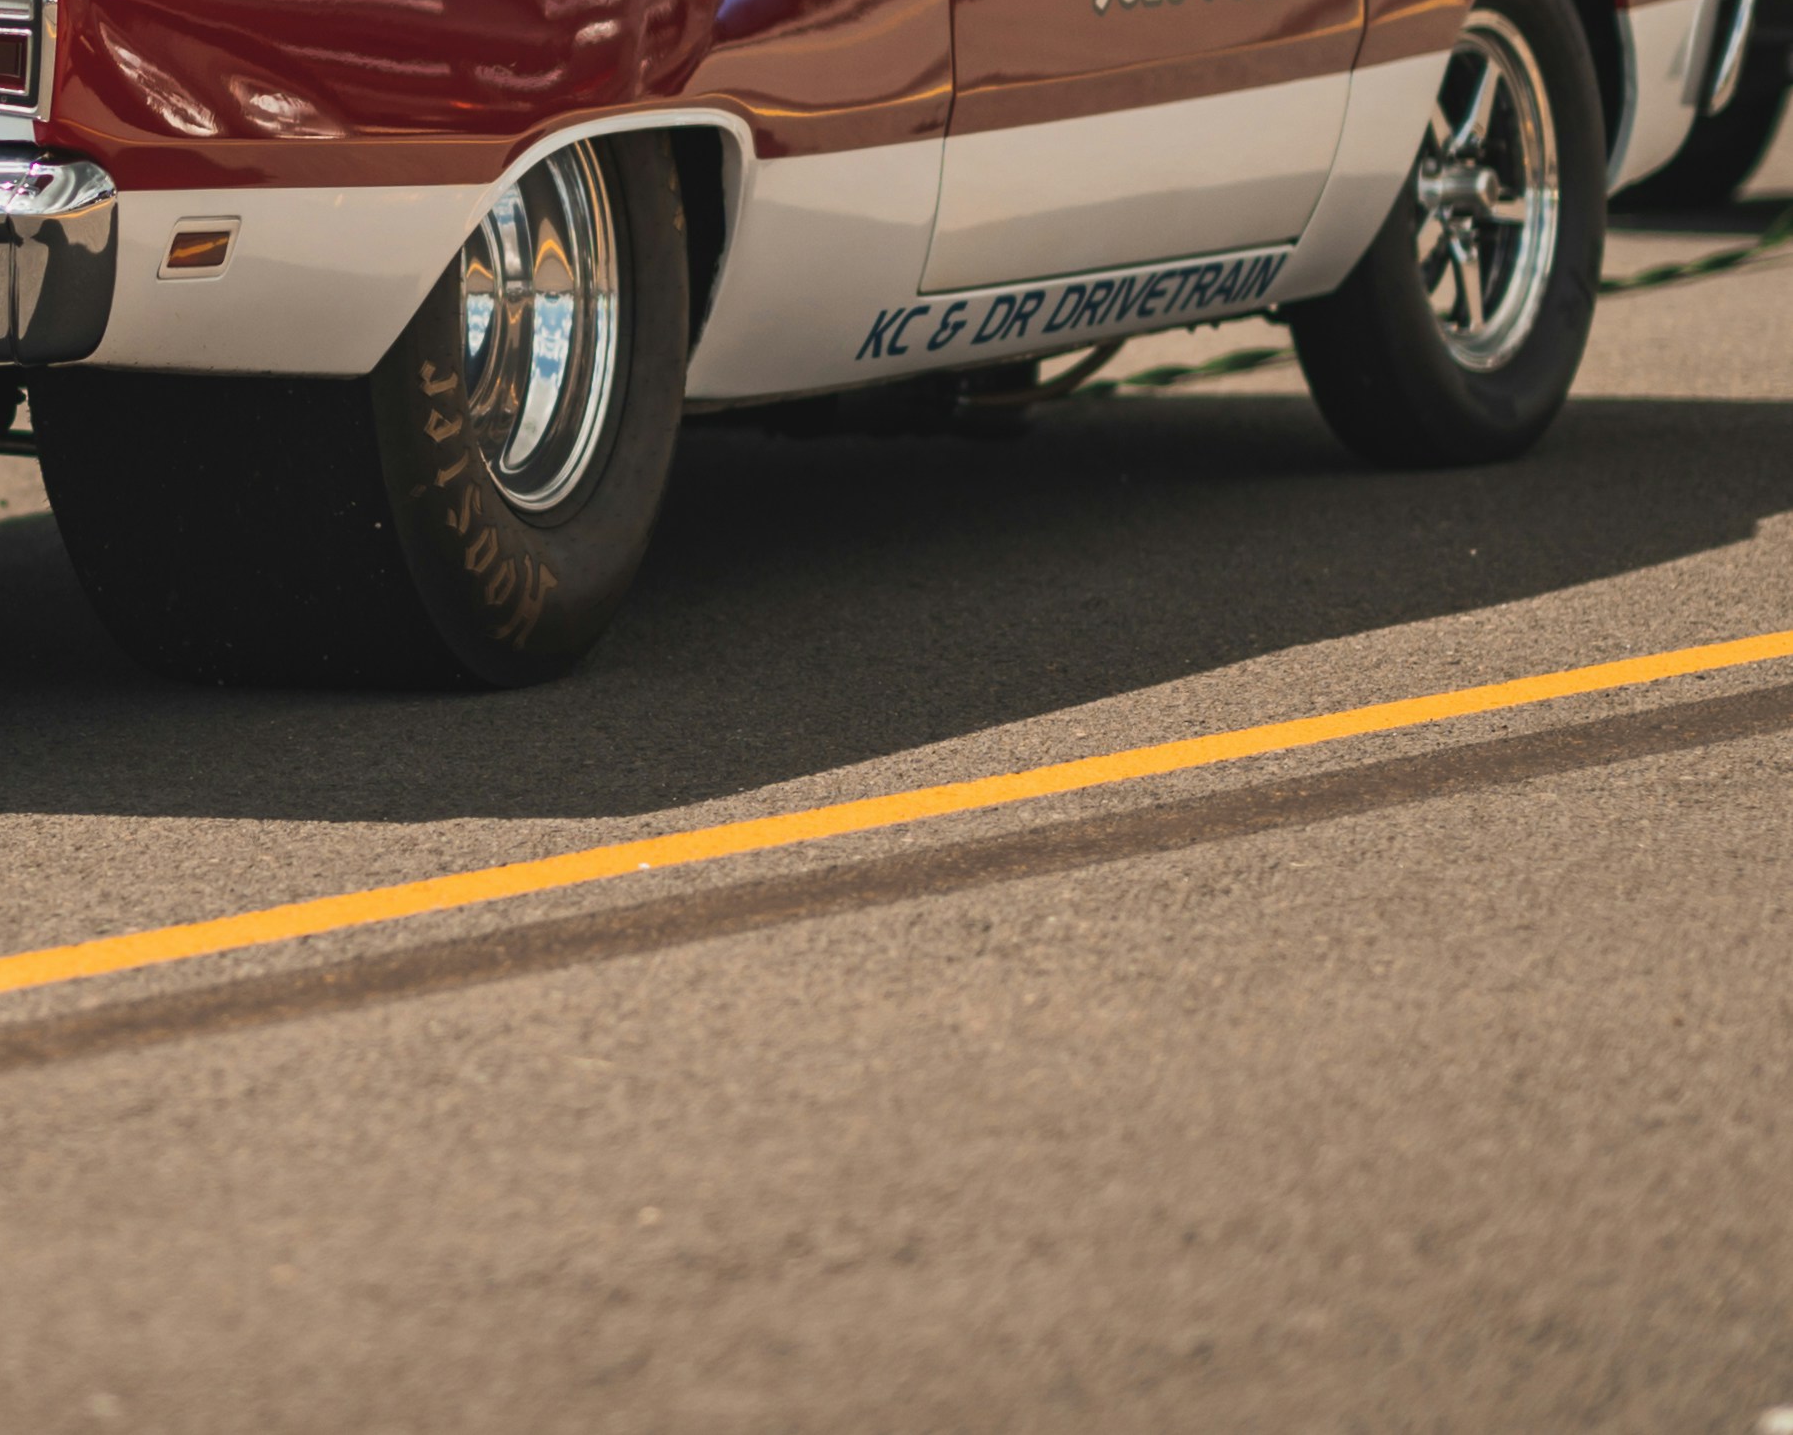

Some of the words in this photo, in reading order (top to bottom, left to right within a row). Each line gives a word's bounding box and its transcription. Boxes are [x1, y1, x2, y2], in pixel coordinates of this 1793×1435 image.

[855, 304, 930, 361] KC
[926, 300, 969, 352] &
[970, 289, 1046, 346] DR
[1041, 251, 1289, 335] DRIVETRAIN
